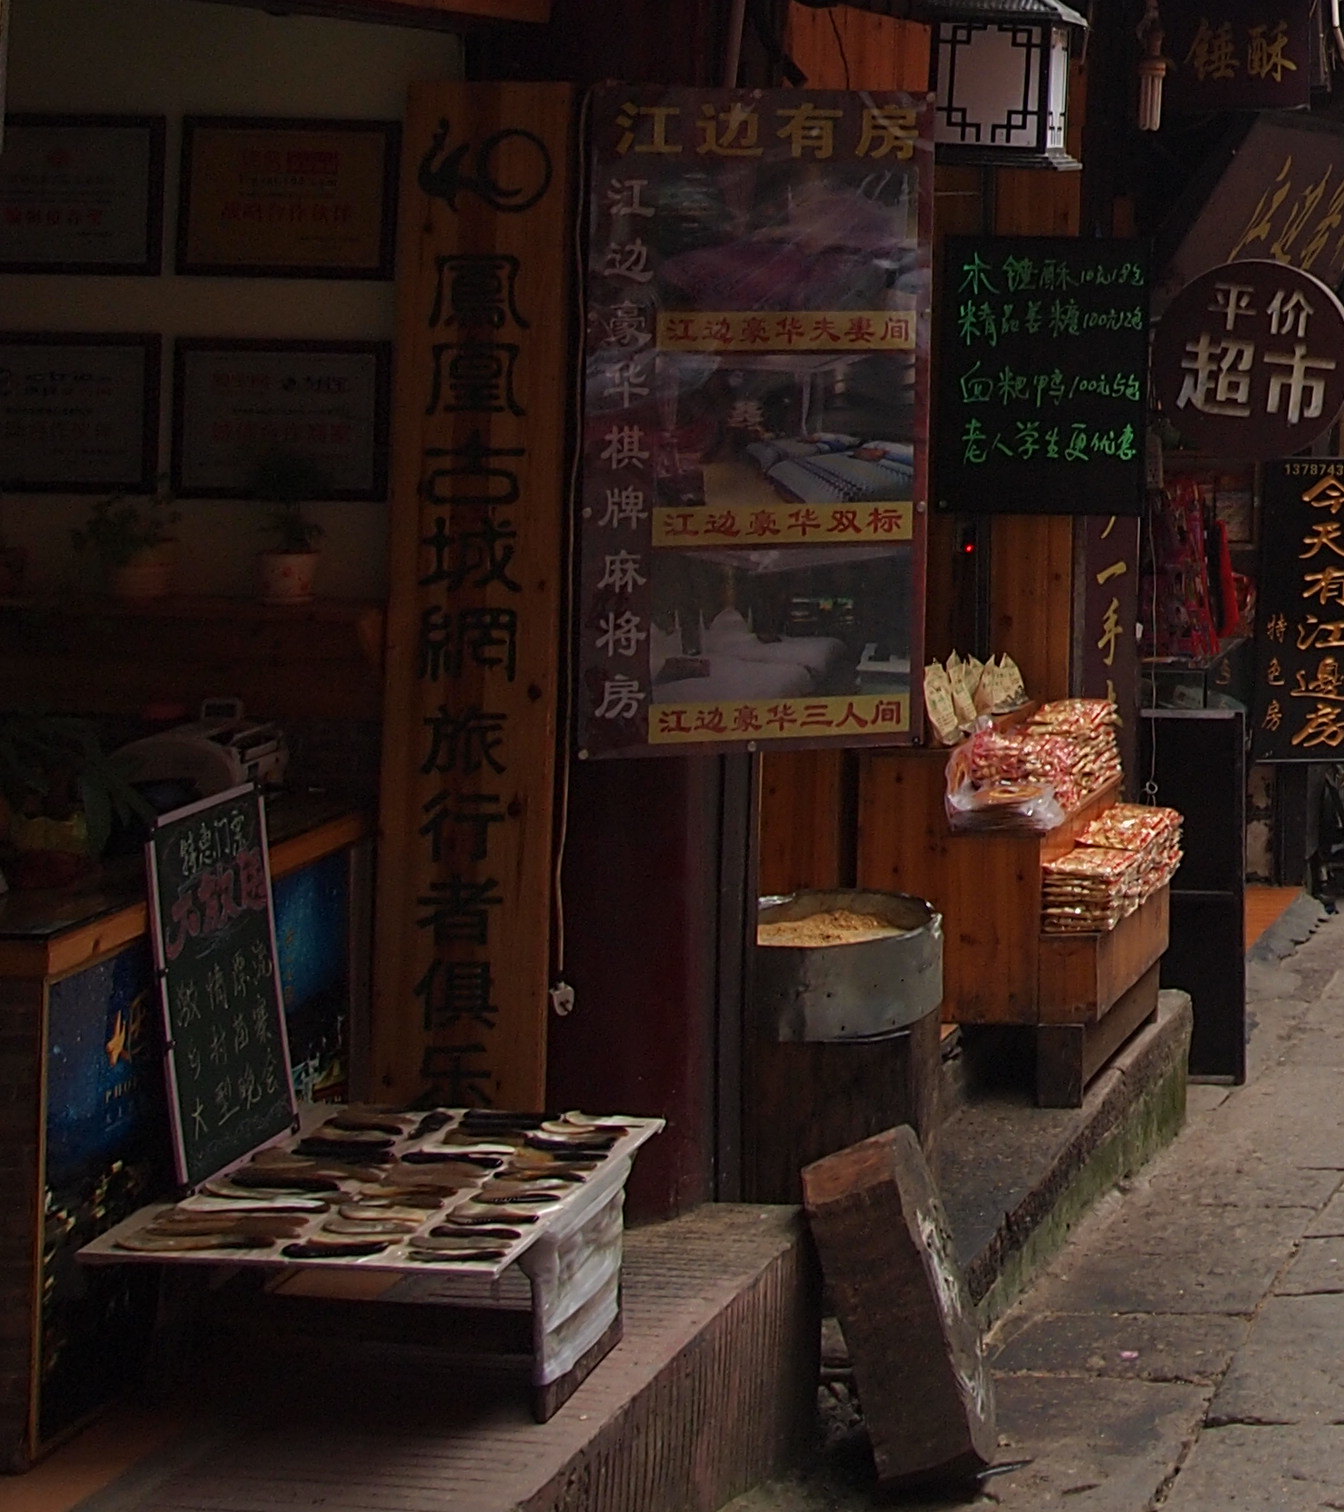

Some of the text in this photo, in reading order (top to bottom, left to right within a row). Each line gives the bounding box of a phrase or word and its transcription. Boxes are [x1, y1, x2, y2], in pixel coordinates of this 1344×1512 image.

[615, 100, 921, 161] 江边有房
[666, 315, 910, 345] 江边豪华夫妻间
[1207, 282, 1315, 338] 平价
[1175, 331, 1337, 426] 超市
[594, 178, 656, 720] 江边豪华棋牌麻将房
[961, 417, 1138, 465] 老人学生更优惠
[663, 507, 904, 538] 江边豪华双标
[1261, 612, 1289, 732] 特色房
[658, 699, 902, 734] 江边豪华三人间
